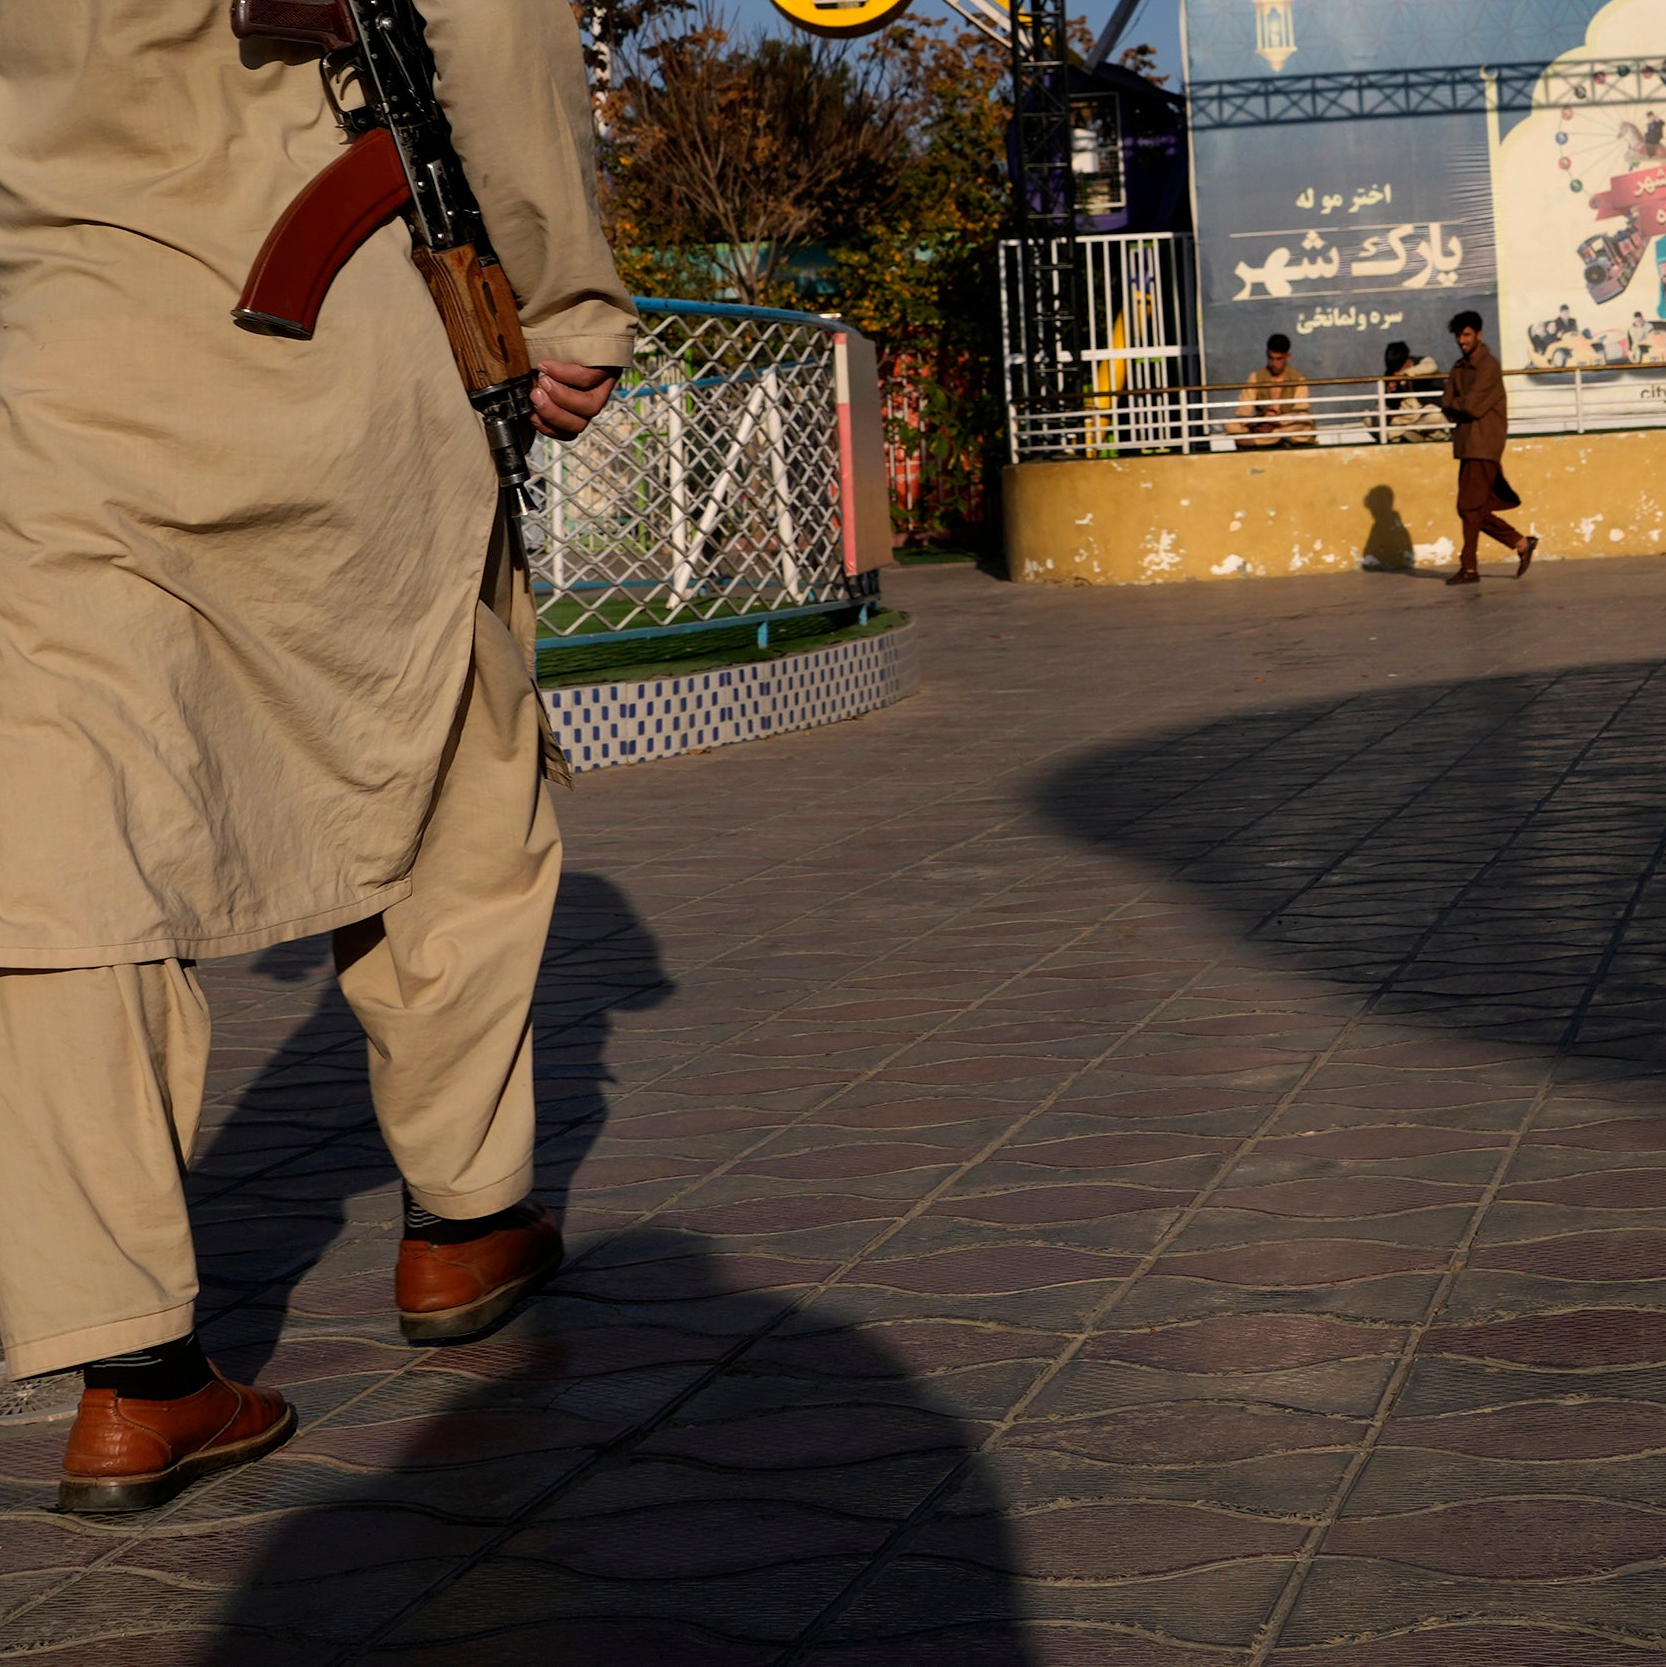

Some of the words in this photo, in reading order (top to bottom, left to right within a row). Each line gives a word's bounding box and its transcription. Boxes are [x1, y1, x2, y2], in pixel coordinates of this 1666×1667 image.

[1295, 186, 1315, 209] له
[1320, 194, 1343, 215] مو
[1348, 183, 1392, 214] اختر
[1232, 230, 1341, 301] شهر
[1369, 310, 1404, 330] سره
